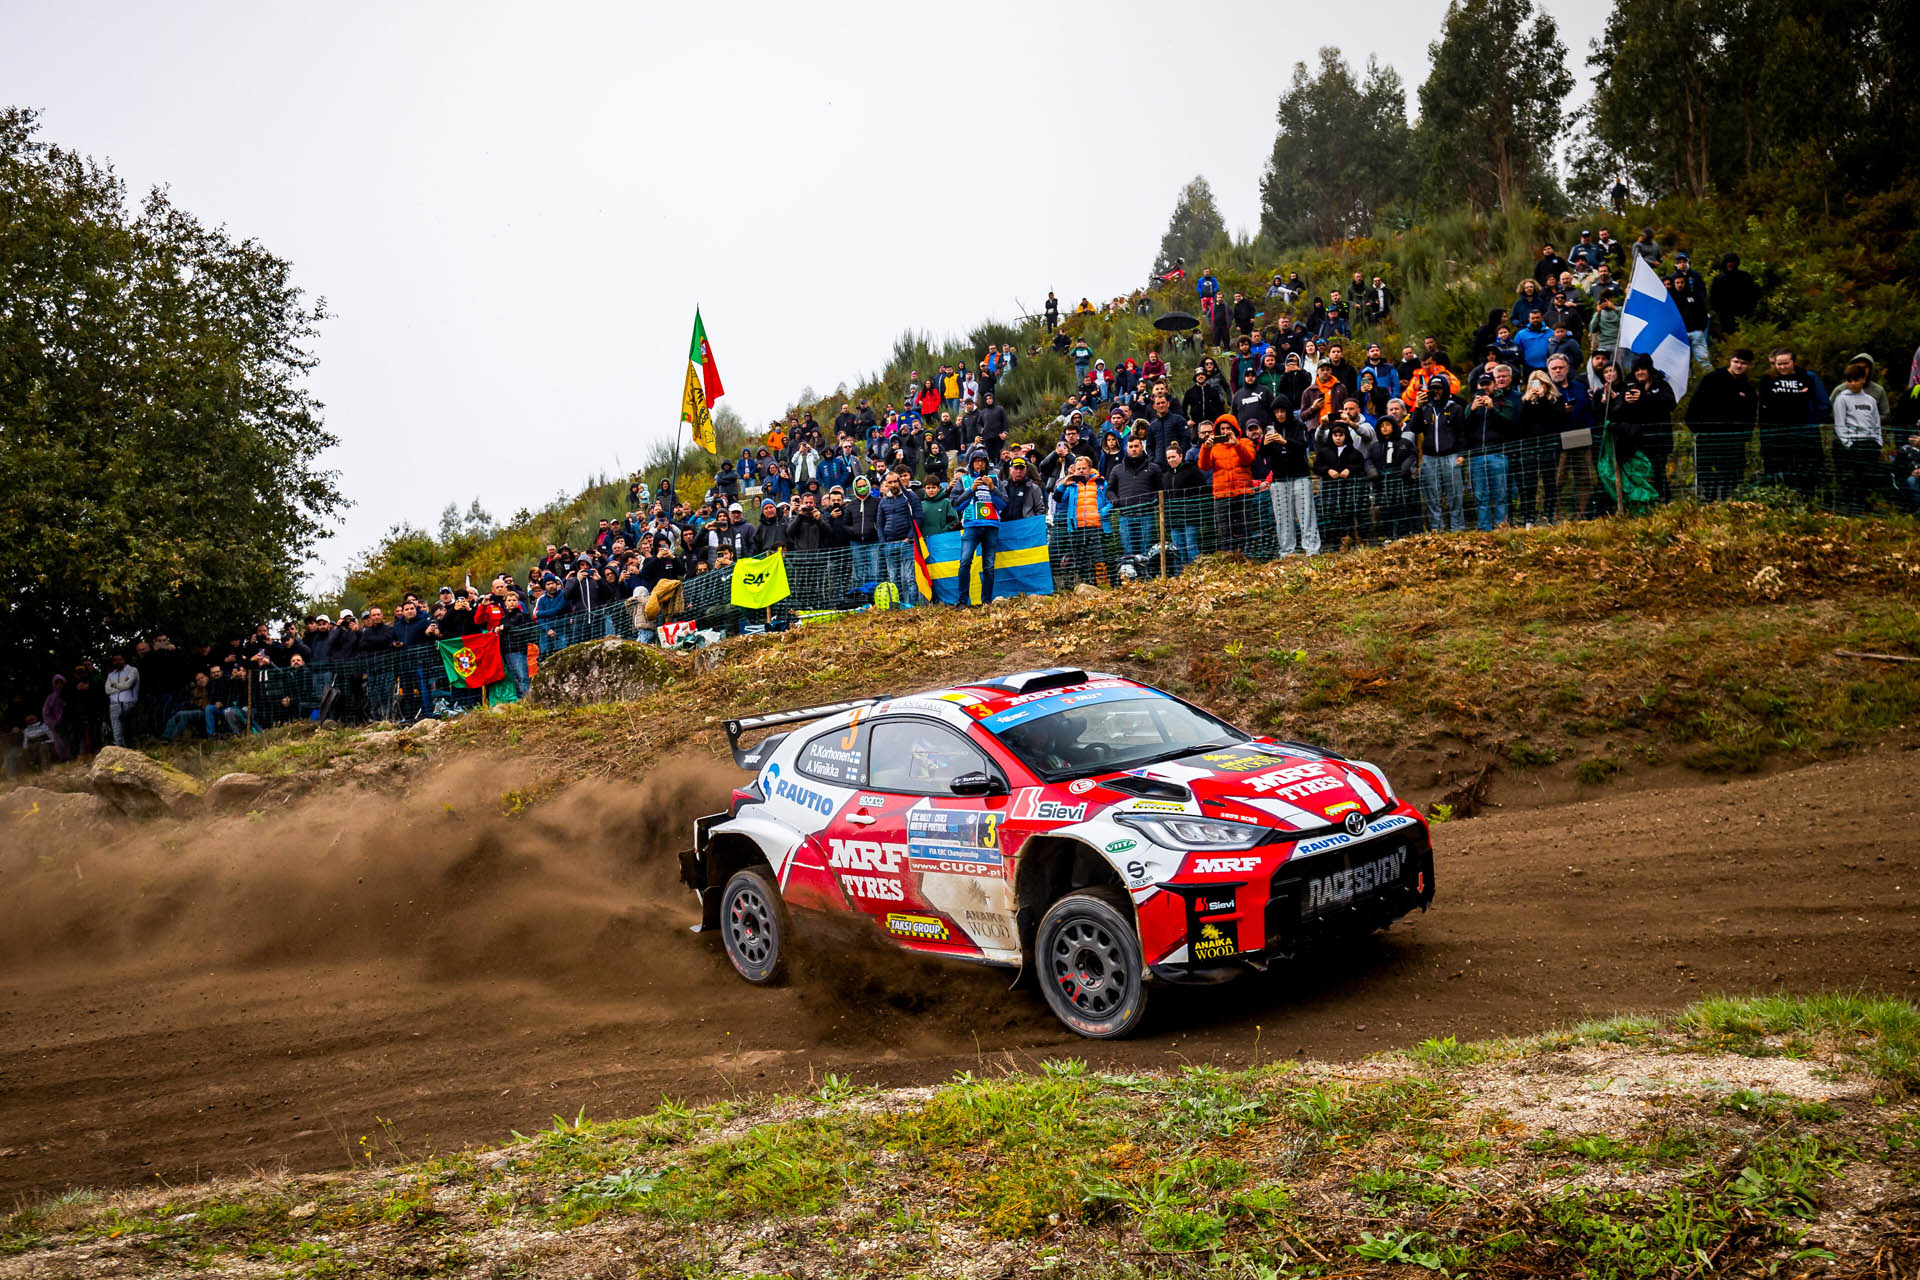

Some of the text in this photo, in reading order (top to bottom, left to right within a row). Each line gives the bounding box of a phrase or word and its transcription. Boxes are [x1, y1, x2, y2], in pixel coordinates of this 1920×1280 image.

[1779, 380, 1799, 389] THE
[969, 703, 994, 718] 3
[841, 708, 863, 751] 3
[810, 743, 851, 763] R.Korhonen
[806, 759, 839, 778] A.Viinikka
[1241, 763, 1327, 793] MRF
[1275, 776, 1345, 801] TYRES
[775, 779, 834, 816] RAUTIO
[1038, 803, 1085, 819] Sievi
[983, 814, 997, 848] 3
[1368, 816, 1407, 833] RAUTIO
[1298, 834, 1351, 855] RAUTIO
[828, 839, 909, 873] MRF
[911, 861, 1001, 877] www.CUCP.pt
[1193, 857, 1262, 873] MRF
[841, 874, 905, 901] TYRES
[1209, 899, 1235, 910] Sievi
[965, 910, 1006, 924] ANAIKA
[891, 919, 941, 935] TAKSI GROUP
[1194, 937, 1233, 950] ANAIKA
[1195, 945, 1235, 960] WOOD
